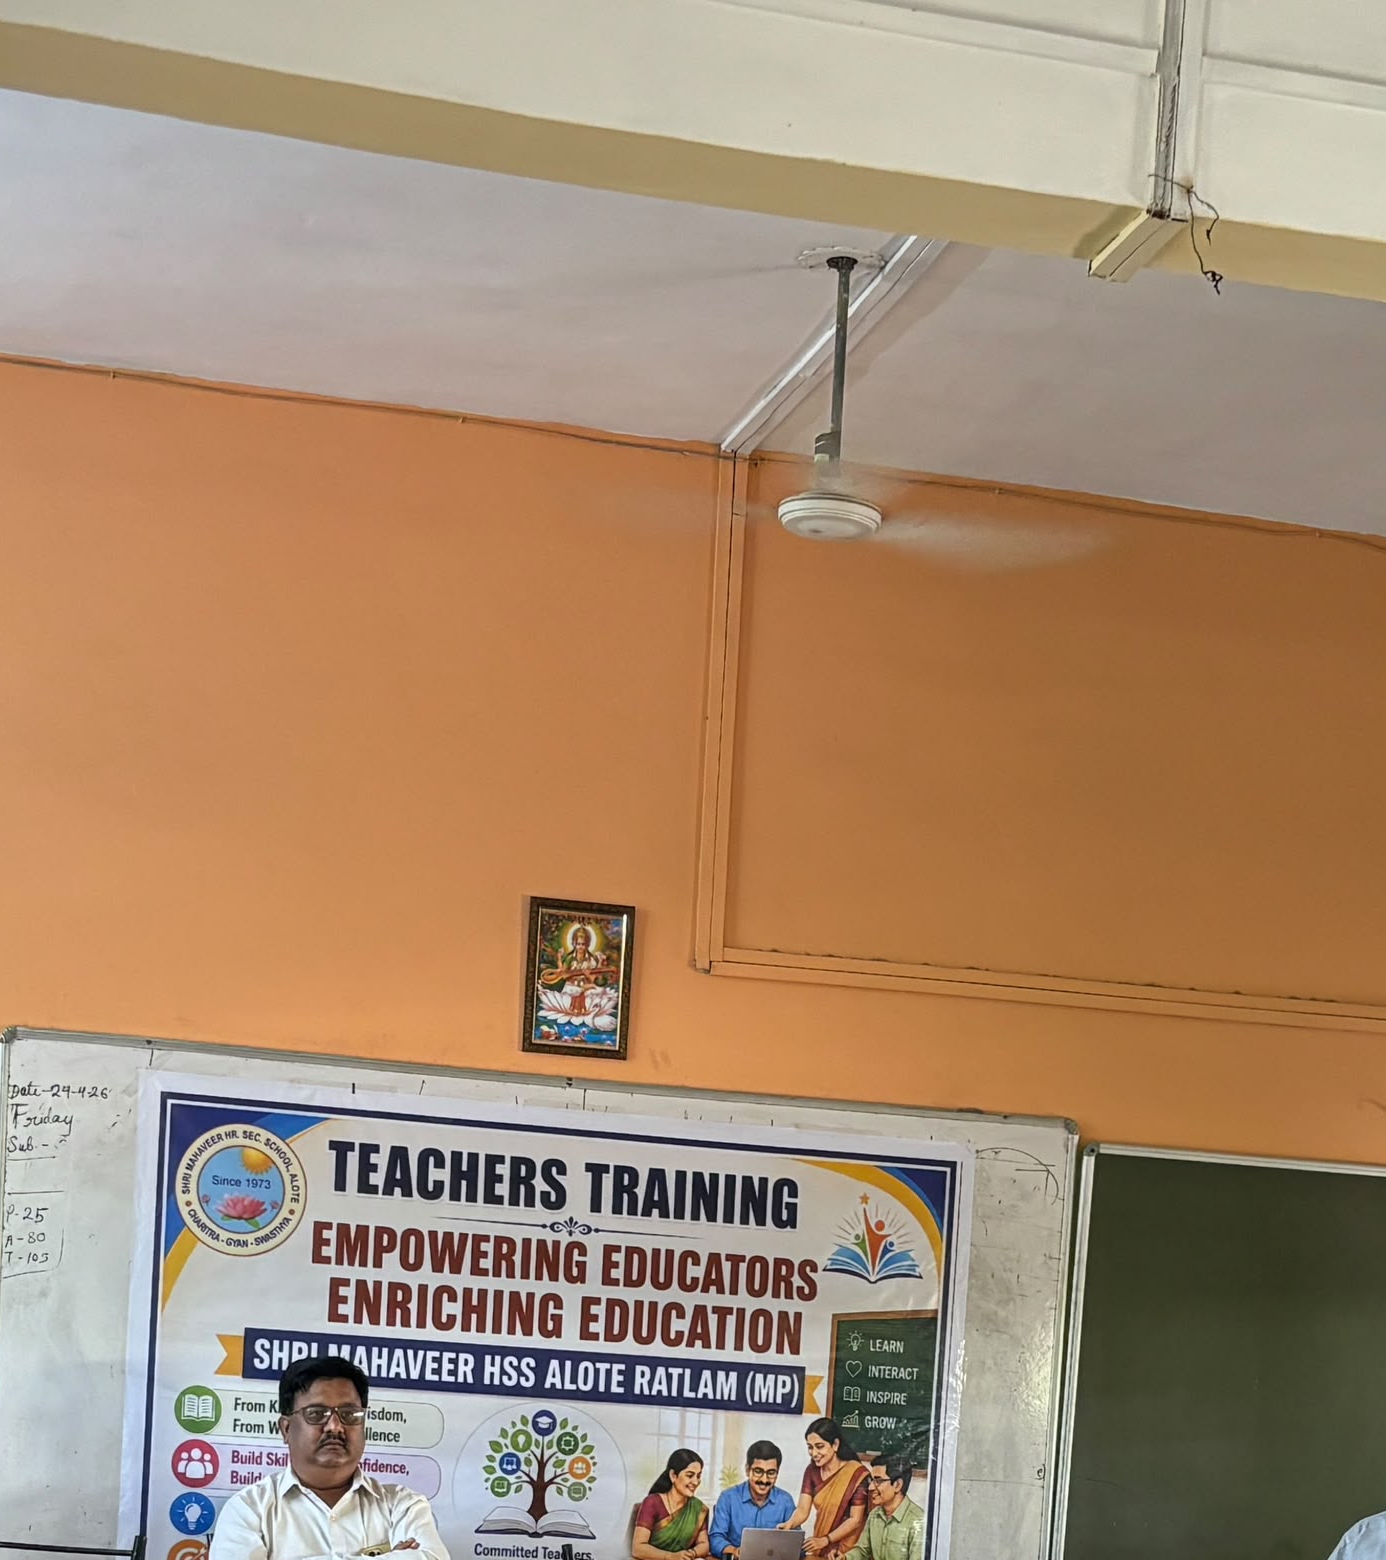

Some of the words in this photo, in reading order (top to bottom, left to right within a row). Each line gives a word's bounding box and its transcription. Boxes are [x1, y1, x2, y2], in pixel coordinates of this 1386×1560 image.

[10, 1103, 73, 1136] Friday
[242, 1130, 262, 1144] SEC.
[185, 1133, 224, 1172] MAHAVEER
[182, 1172, 191, 1194] SHRI
[211, 1175, 242, 1187] Since
[246, 1178, 271, 1189] 1973
[289, 1173, 300, 1204] ALOTE
[328, 1140, 567, 1211] TEACHERS
[584, 1162, 799, 1230] TRAINING
[187, 1208, 220, 1243] CHARITRA
[225, 1237, 249, 1248] GYAN
[311, 1220, 587, 1286] EMPOWERING
[601, 1243, 819, 1302] EDUCATORS
[327, 1277, 564, 1340] ENRICHING
[579, 1296, 803, 1356] EDUCATION
[869, 1339, 904, 1354] LEARN
[483, 1355, 536, 1388] HSS
[544, 1359, 625, 1395] ALOTE
[633, 1365, 737, 1402] RATLAM
[745, 1370, 800, 1408] (MP)
[868, 1365, 919, 1380] INTERACT
[866, 1390, 908, 1405] INSPIRE
[233, 1397, 265, 1413] From
[365, 1406, 407, 1424] isdom,
[864, 1415, 897, 1429] GROW
[233, 1418, 264, 1434] From
[365, 1428, 401, 1443] llence
[231, 1450, 263, 1466] Build
[266, 1452, 289, 1467] Skil
[359, 1458, 410, 1476] nfidence,
[230, 1471, 262, 1486] Build
[474, 1543, 538, 1559] Committed
